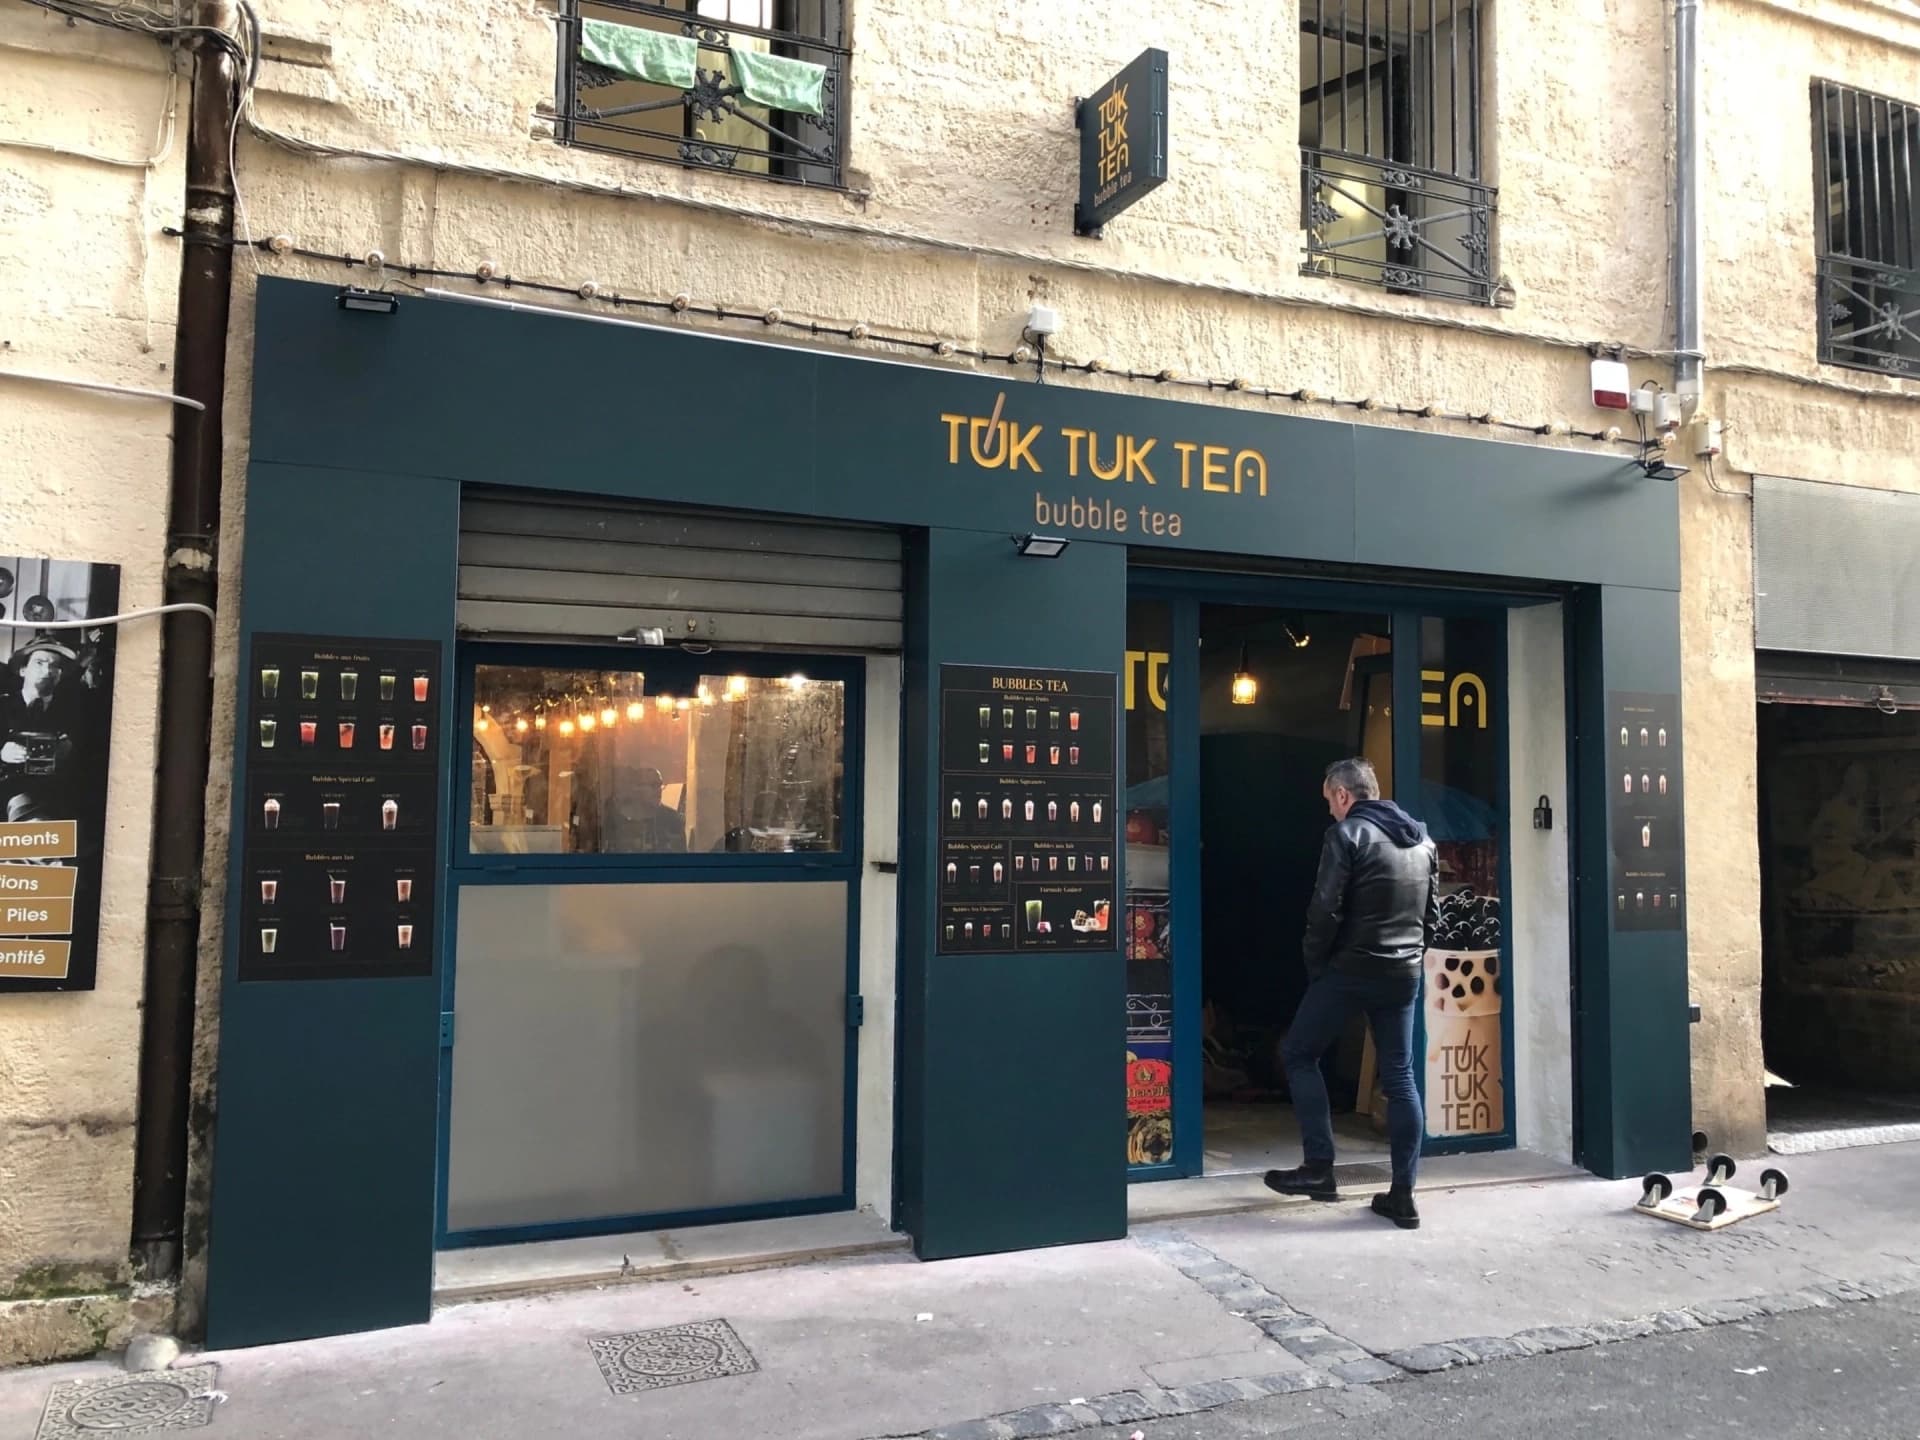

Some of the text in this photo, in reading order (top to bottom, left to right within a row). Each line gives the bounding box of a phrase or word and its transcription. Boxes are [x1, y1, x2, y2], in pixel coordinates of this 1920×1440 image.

[1098, 80, 1128, 130] TUK
[1098, 111, 1128, 158] TUK
[1098, 142, 1128, 186] TEA
[1094, 170, 1132, 208] bubble tea
[940, 408, 1268, 497] TUK TUK TEA
[1035, 491, 1182, 537] bubble tea
[992, 677, 1069, 693] BUBBLES TEA
[0, 831, 60, 847] ments
[0, 874, 39, 890] ions
[8, 907, 48, 922] Piles
[1440, 1038, 1489, 1072] TUK
[1440, 1073, 1489, 1101] TUK
[1440, 1102, 1491, 1131] TEA
